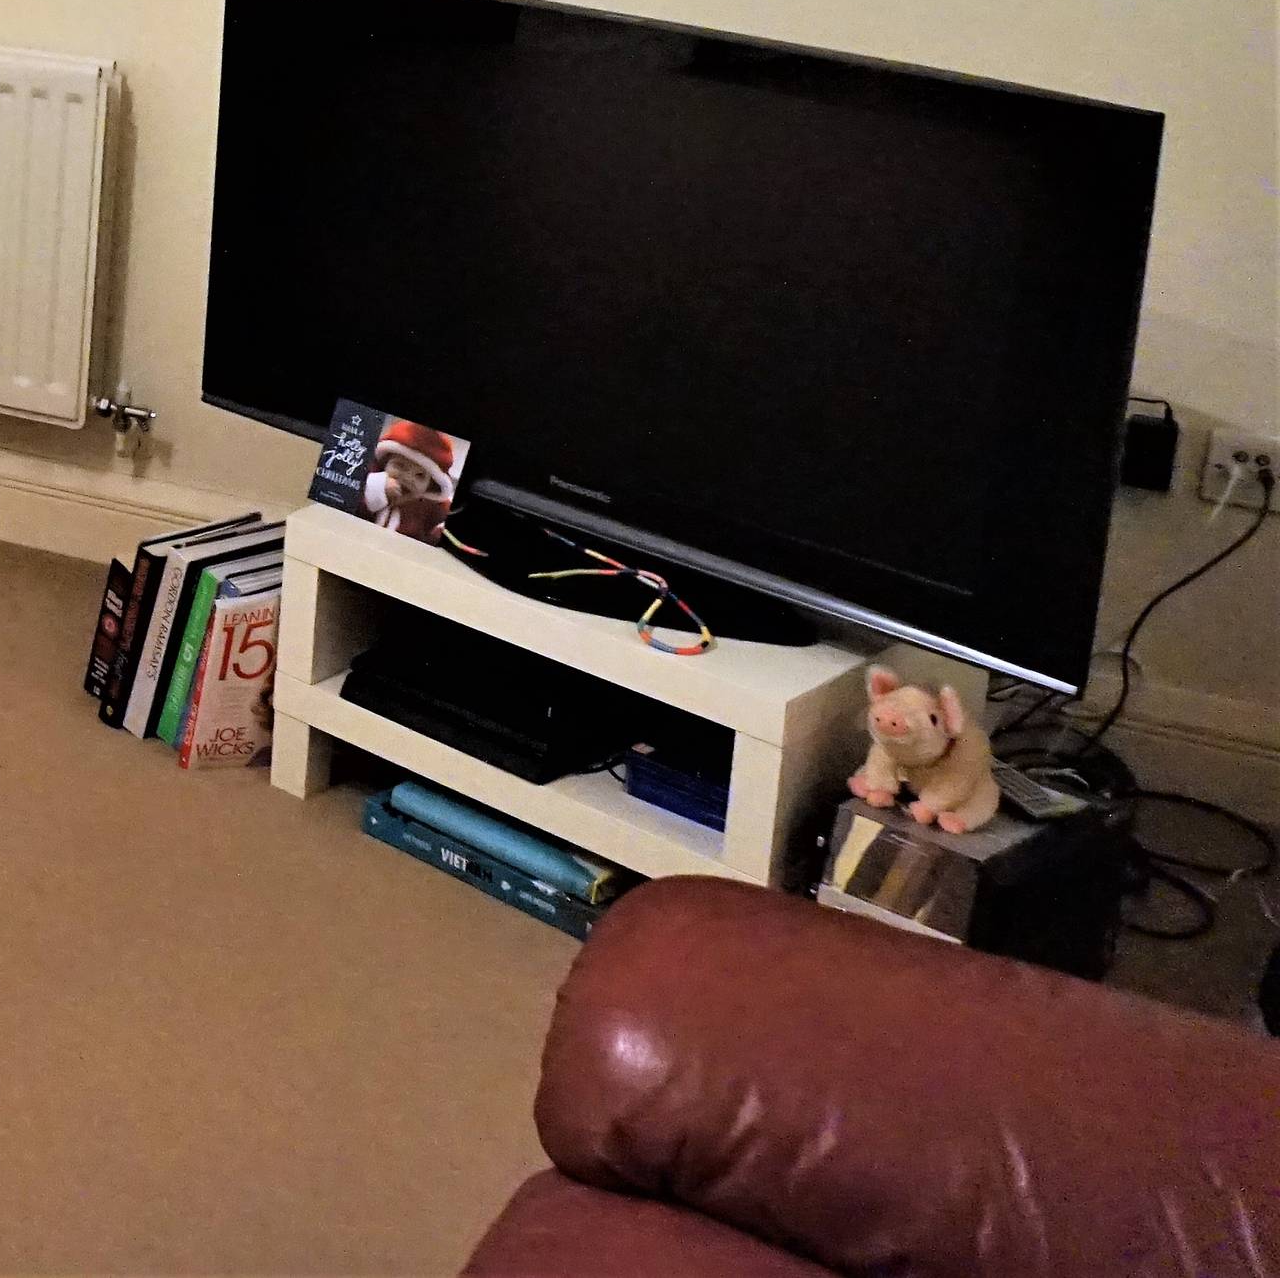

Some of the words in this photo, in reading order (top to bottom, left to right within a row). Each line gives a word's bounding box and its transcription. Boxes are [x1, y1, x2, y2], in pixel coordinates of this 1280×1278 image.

[332, 432, 368, 459] holly
[323, 446, 364, 476] jolly
[316, 467, 361, 490] CHRISTMAS
[162, 567, 182, 624] GORDON
[224, 609, 261, 626] LEAN
[262, 608, 274, 622] IN
[146, 624, 169, 681] RAMSAY'S
[218, 619, 275, 681] 15
[209, 726, 246, 742] JOE
[196, 741, 256, 757] WICKS
